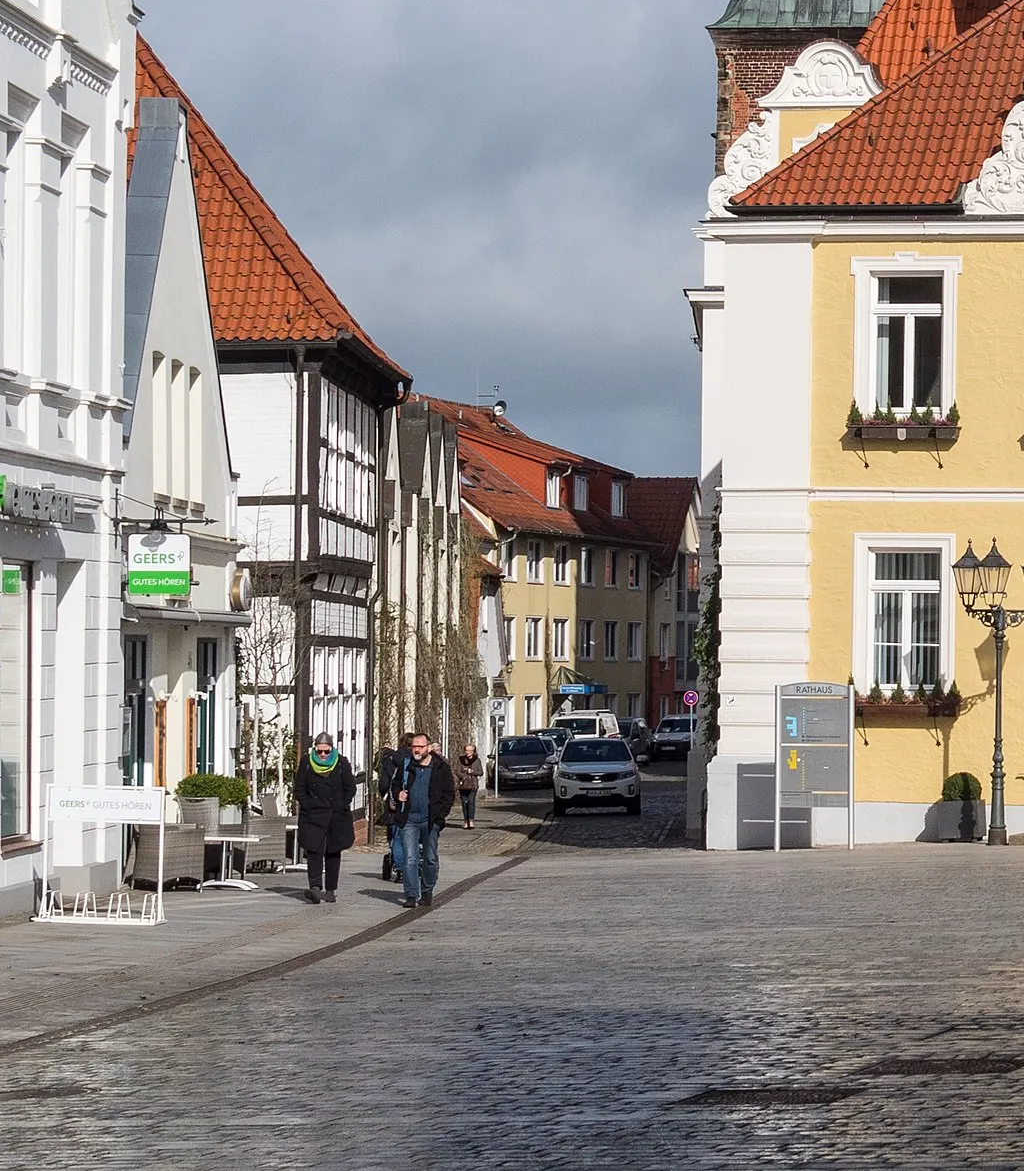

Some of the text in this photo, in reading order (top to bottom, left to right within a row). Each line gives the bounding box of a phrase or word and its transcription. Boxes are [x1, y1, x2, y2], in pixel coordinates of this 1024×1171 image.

[133, 553, 176, 564] GEERS
[132, 576, 186, 586] GUTES HÖREN
[796, 685, 833, 694] RATHAUS
[59, 799, 152, 810] GEERS GUTES HÖREN
